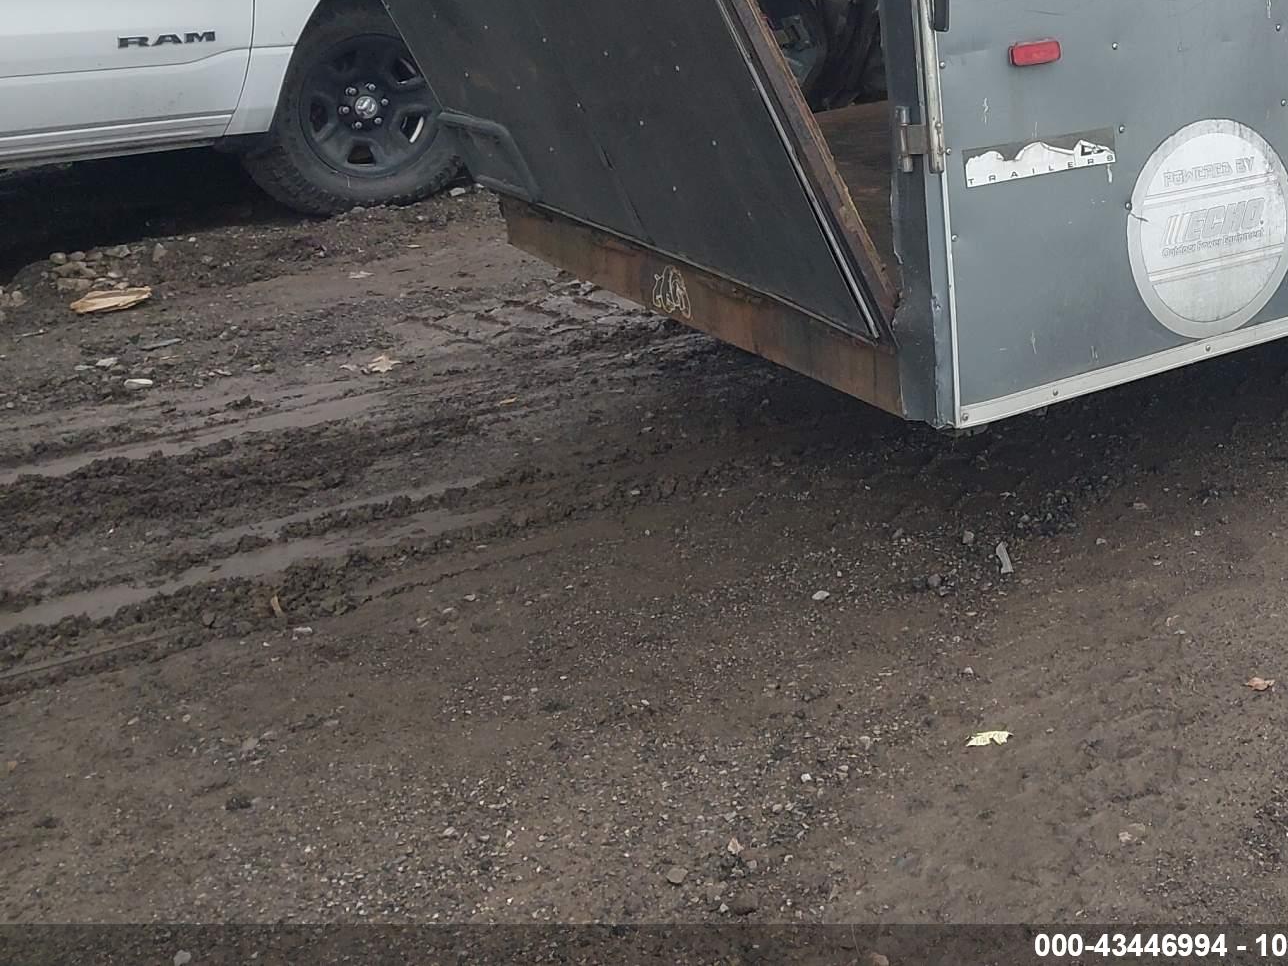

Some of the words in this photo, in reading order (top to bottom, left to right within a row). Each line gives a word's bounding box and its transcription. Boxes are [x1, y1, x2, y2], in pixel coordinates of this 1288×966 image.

[117, 31, 216, 49] RAM
[968, 154, 1114, 185] TRAILERS
[1164, 161, 1234, 187] POWERED
[1235, 156, 1255, 174] BY
[1180, 197, 1266, 242] ECHO
